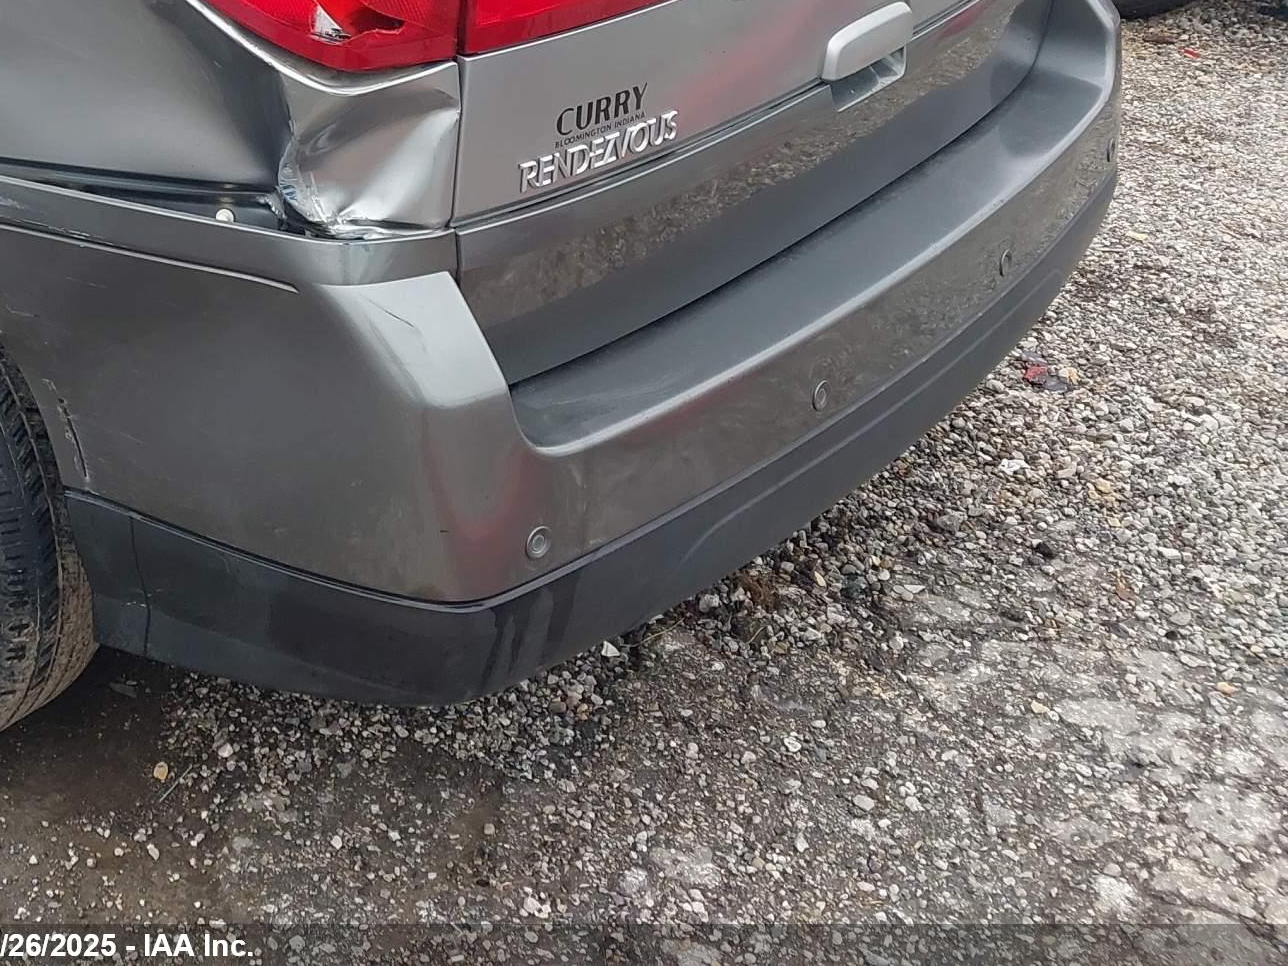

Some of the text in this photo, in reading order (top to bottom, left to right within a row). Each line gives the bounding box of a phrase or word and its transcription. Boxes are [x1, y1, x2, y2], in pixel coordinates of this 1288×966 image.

[554, 111, 646, 149] BLOOMINGTON INDIANA
[556, 82, 648, 136] CURRY
[518, 109, 679, 193] RENDEZVOUS
